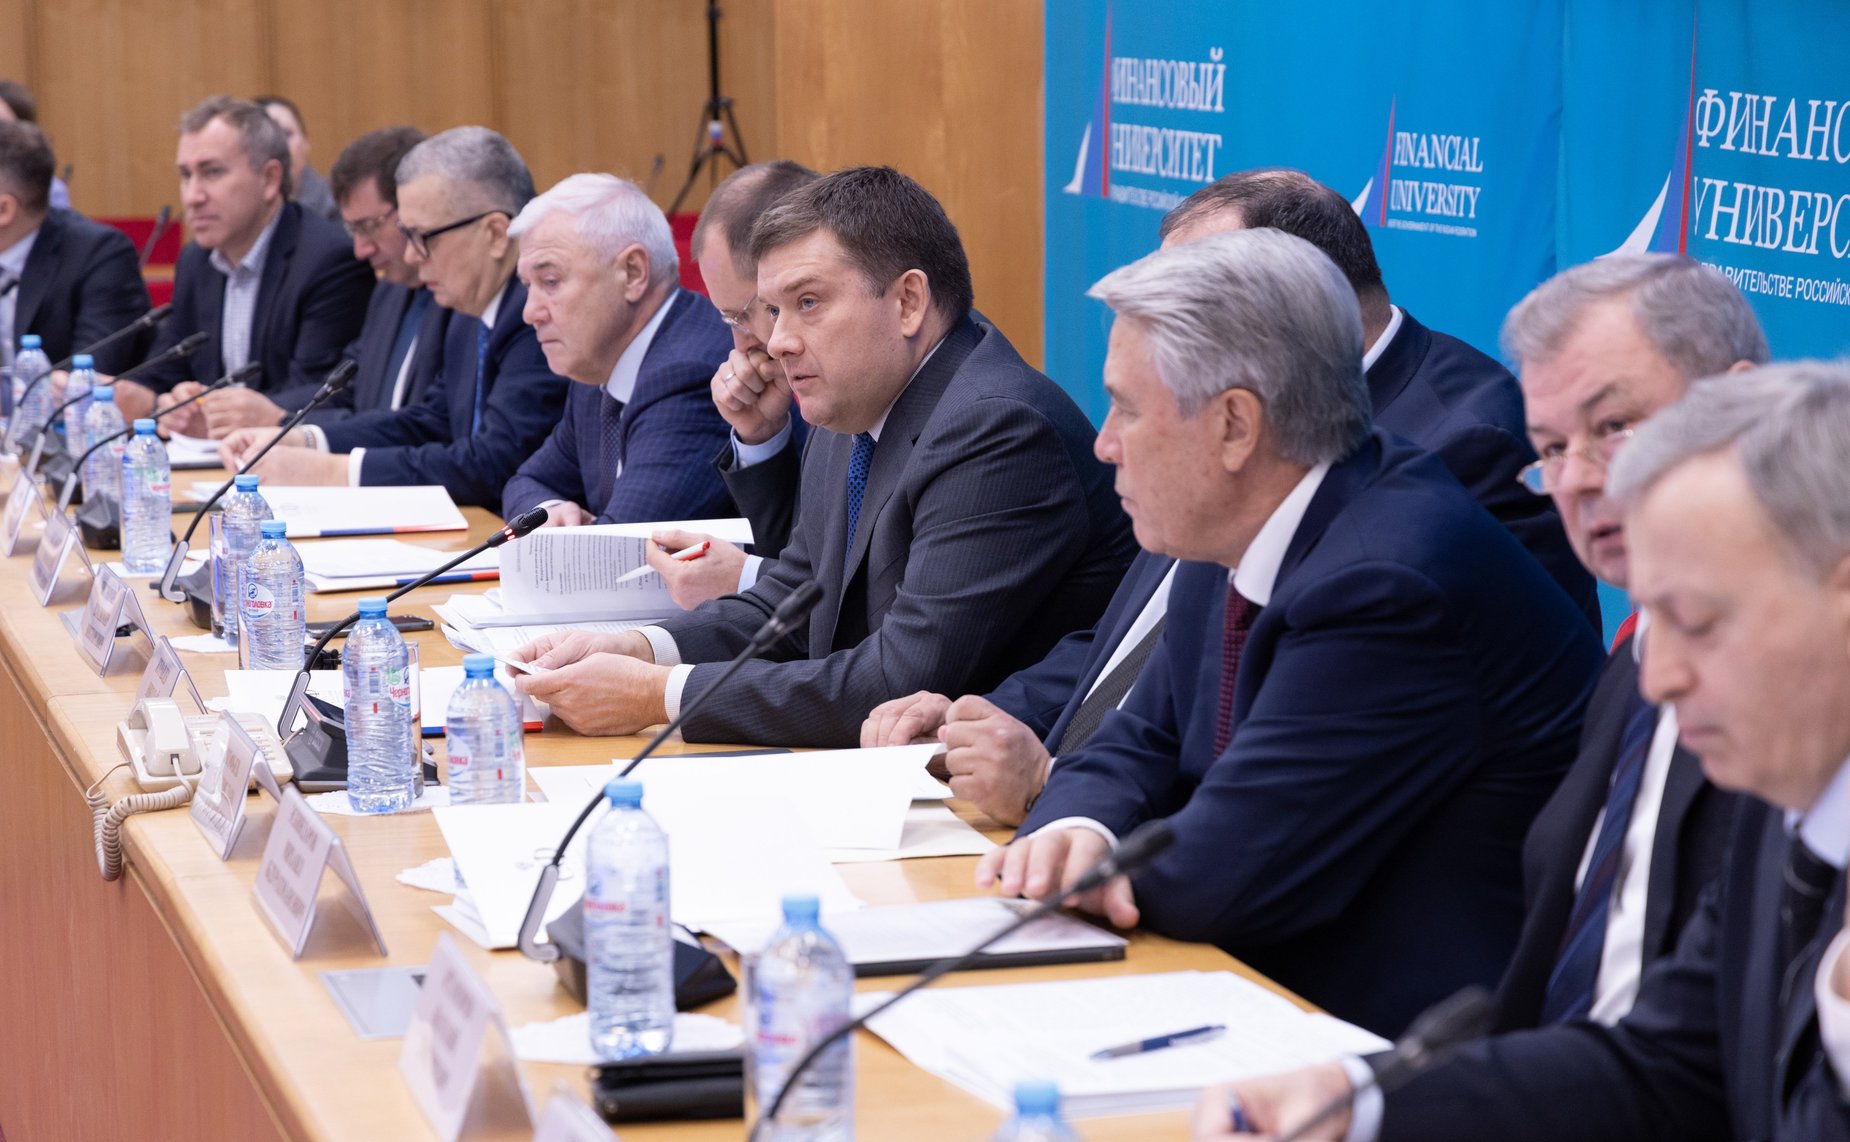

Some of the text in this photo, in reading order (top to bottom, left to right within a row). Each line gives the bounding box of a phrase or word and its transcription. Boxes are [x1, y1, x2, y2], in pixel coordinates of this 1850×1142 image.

[1112, 46, 1226, 113] ИНАНСОВЫЙ
[1111, 122, 1222, 183] НИВЕРСИТЕТ
[1393, 131, 1484, 173] FINANCIAL
[1390, 179, 1481, 219] UNIVERSITY
